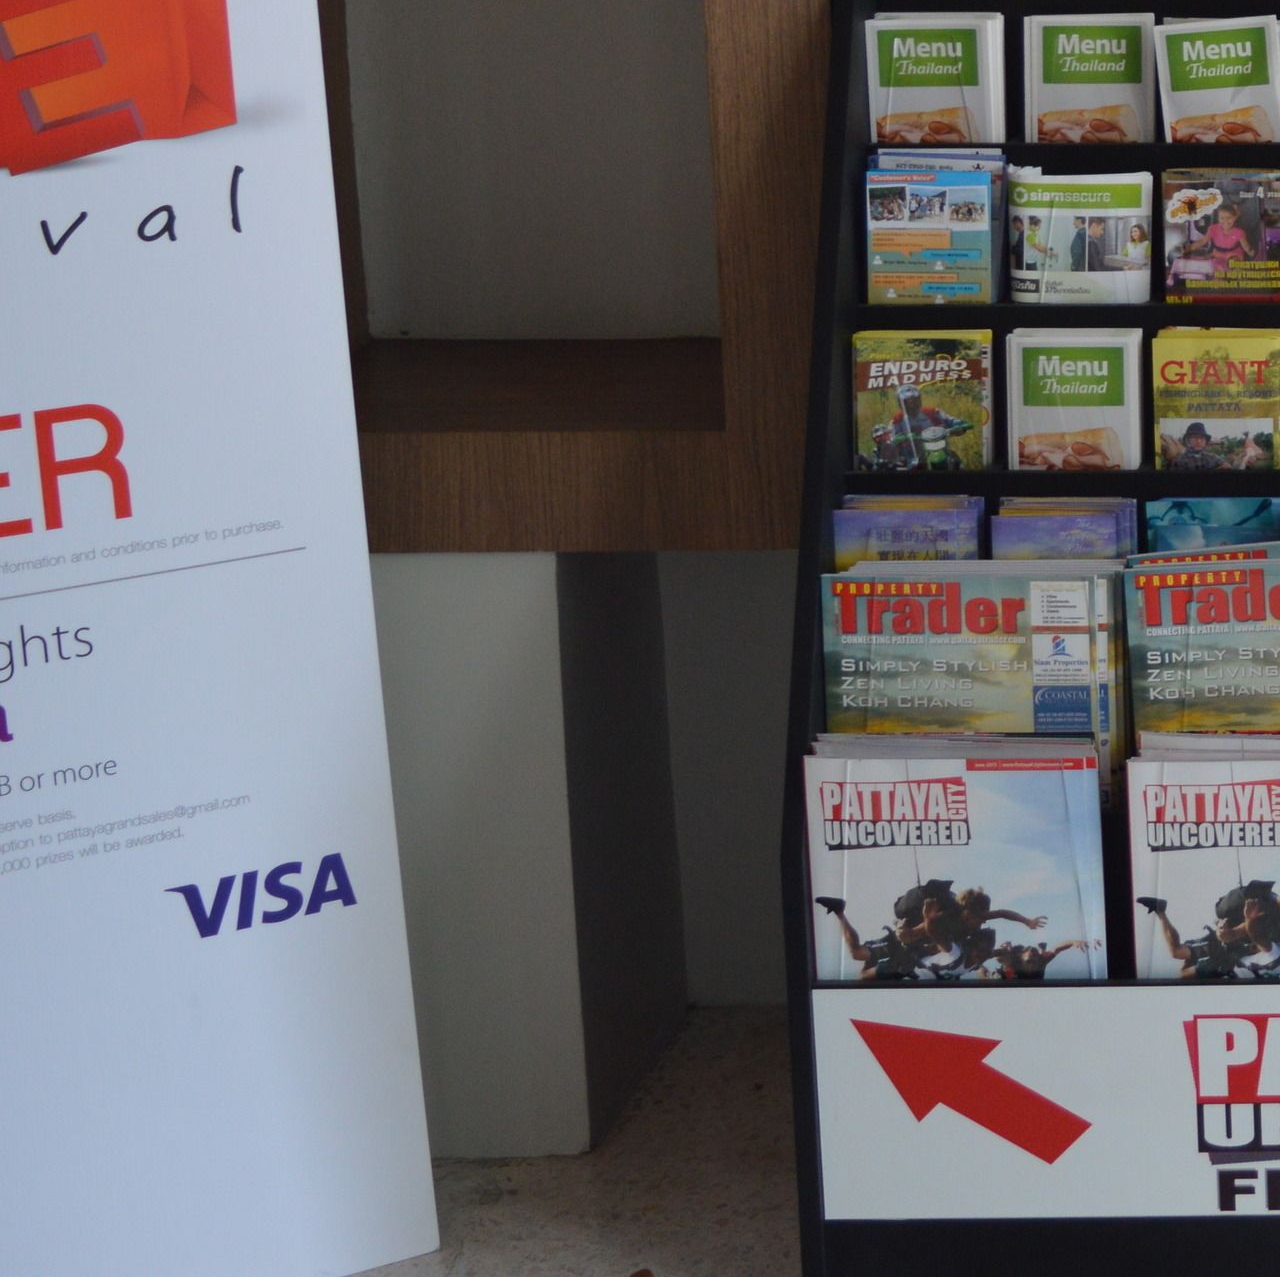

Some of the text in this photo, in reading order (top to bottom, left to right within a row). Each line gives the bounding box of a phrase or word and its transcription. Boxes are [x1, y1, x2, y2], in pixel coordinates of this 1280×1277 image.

[892, 36, 962, 58] Menu
[896, 59, 962, 76] Thailand
[1029, 188, 1112, 203] siamsecure
[868, 359, 968, 377] ENDURO
[1037, 355, 1109, 377] Menu
[1160, 359, 1271, 385] GIANT
[867, 369, 972, 390] MADNESS
[1040, 378, 1108, 396] Thailand
[71, 548, 96, 564] and
[101, 537, 168, 559] conditions
[172, 532, 200, 548] prior
[205, 529, 217, 542] to
[835, 582, 938, 595] PROPERTY
[1139, 570, 1242, 588] PROPERTY
[838, 581, 1027, 635] Trader
[841, 658, 1028, 672] SIMPLY STYLISH
[1146, 649, 1227, 665] SIMPLY
[841, 676, 974, 690] ZEN LIVING
[841, 694, 974, 708] KOH CHANG
[20, 759, 118, 792] or more
[821, 781, 967, 821] PATTAYA CITY
[1146, 784, 1271, 823] PATTAYA
[38, 808, 76, 825] basis.
[824, 820, 970, 848] UNCOVERED
[163, 852, 358, 939] VISA
